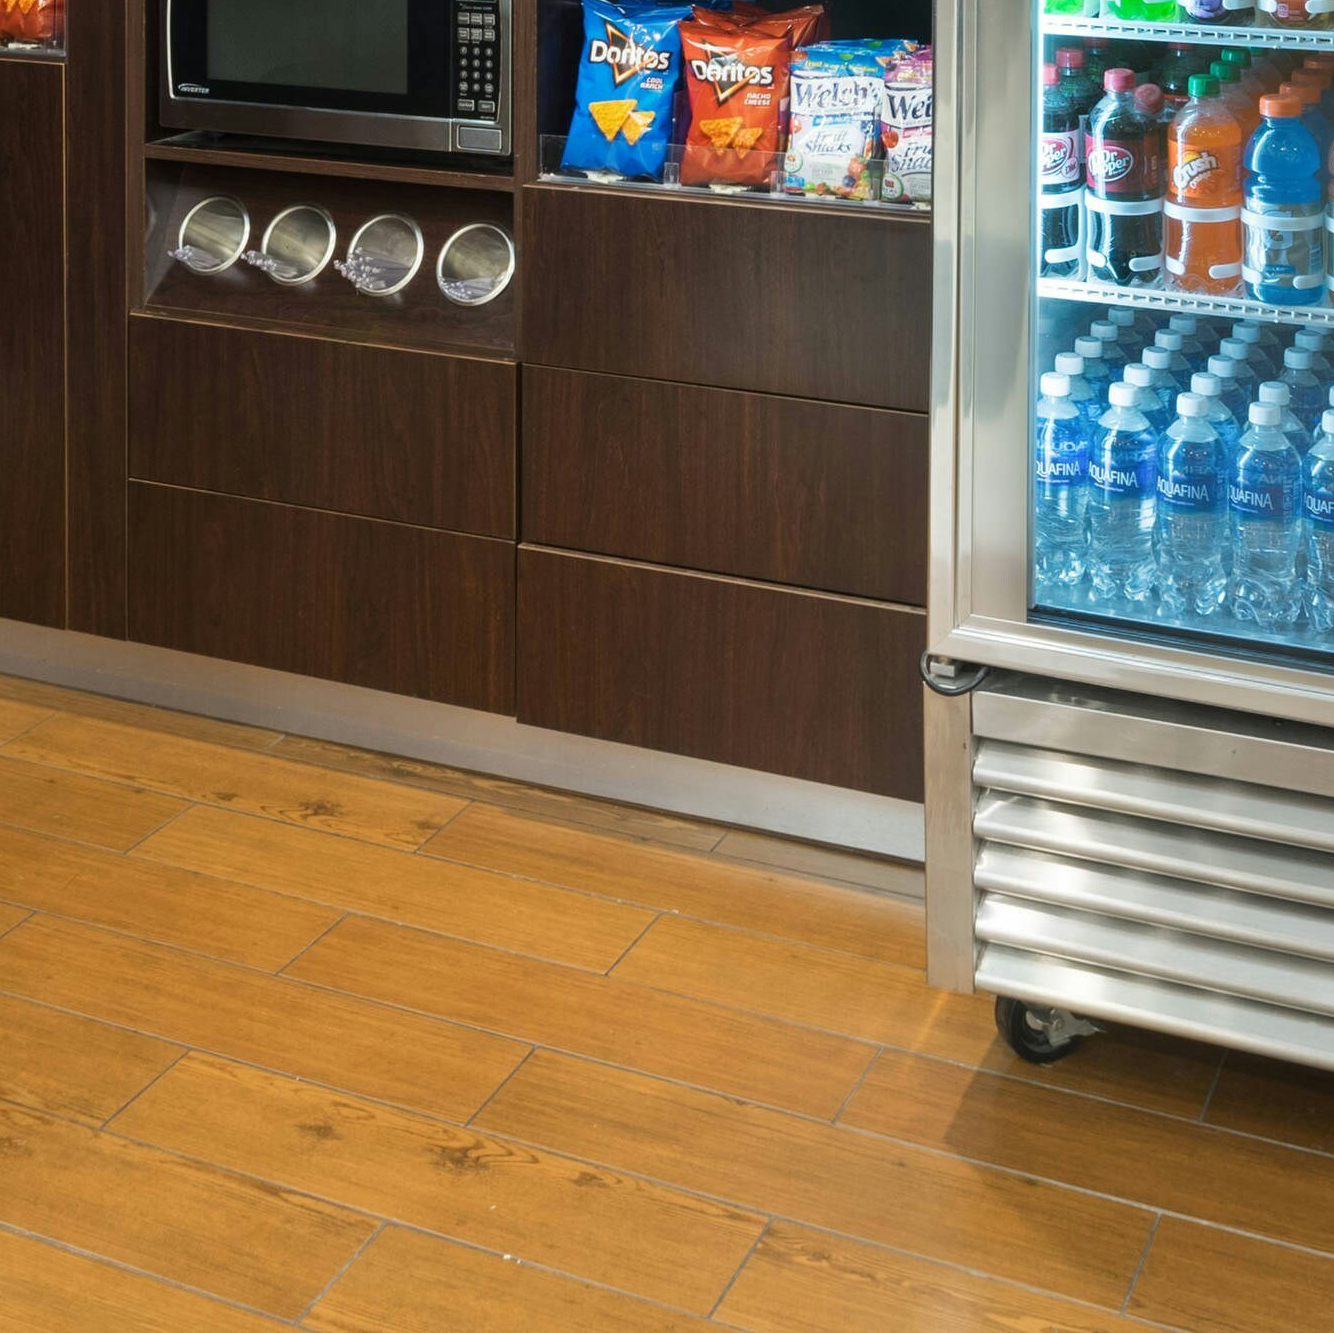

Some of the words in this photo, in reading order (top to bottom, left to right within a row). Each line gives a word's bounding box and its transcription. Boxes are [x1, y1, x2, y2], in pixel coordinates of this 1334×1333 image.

[590, 40, 670, 71] Doritos
[691, 59, 774, 85] Doritos
[746, 93, 772, 101] NACHO
[794, 79, 884, 109] Welch's
[1036, 460, 1081, 476] QUAFINA
[1157, 475, 1209, 502] AQUAFINA
